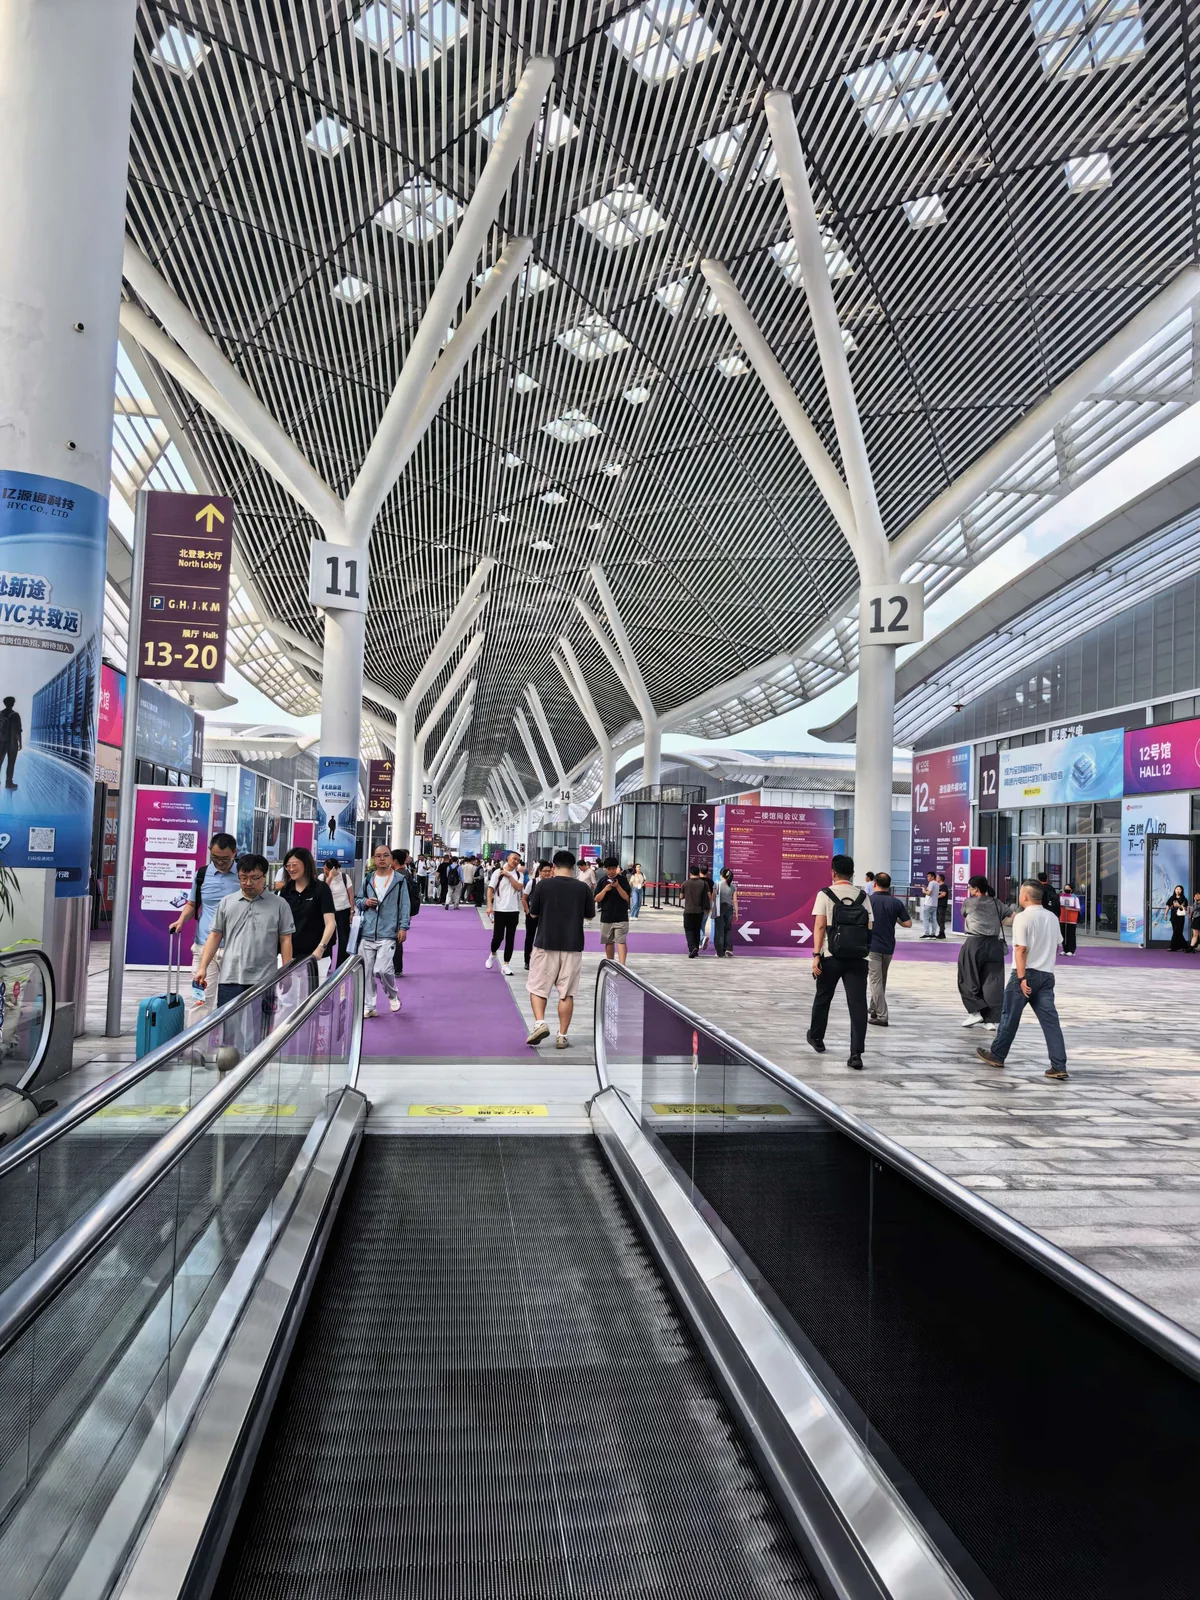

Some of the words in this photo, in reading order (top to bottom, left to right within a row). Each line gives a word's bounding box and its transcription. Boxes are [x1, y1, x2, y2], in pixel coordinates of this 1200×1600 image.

[2, 488, 74, 511] 亿源通科技
[7, 502, 27, 510] HYC
[52, 509, 68, 518] LTD
[179, 549, 222, 560] 北登录大厅
[178, 559, 199, 568] North
[201, 561, 222, 571] Lobby
[326, 556, 359, 599] 11
[869, 595, 909, 633] 12
[182, 629, 199, 638] 展厅
[202, 631, 219, 639] Halls
[144, 641, 218, 670] 13-20
[1139, 741, 1171, 761] 12号馆
[1139, 765, 1161, 778] HALL
[1162, 763, 1171, 775] 12
[983, 769, 996, 795] 12
[423, 784, 432, 794] 13
[561, 790, 570, 800] 14
[915, 782, 929, 813] 12
[370, 800, 390, 808] 13-20
[545, 800, 553, 809] 14
[754, 811, 805, 821] 二楼馆间会议室
[940, 821, 952, 833] 1-10
[1128, 839, 1159, 851] 下一个界
